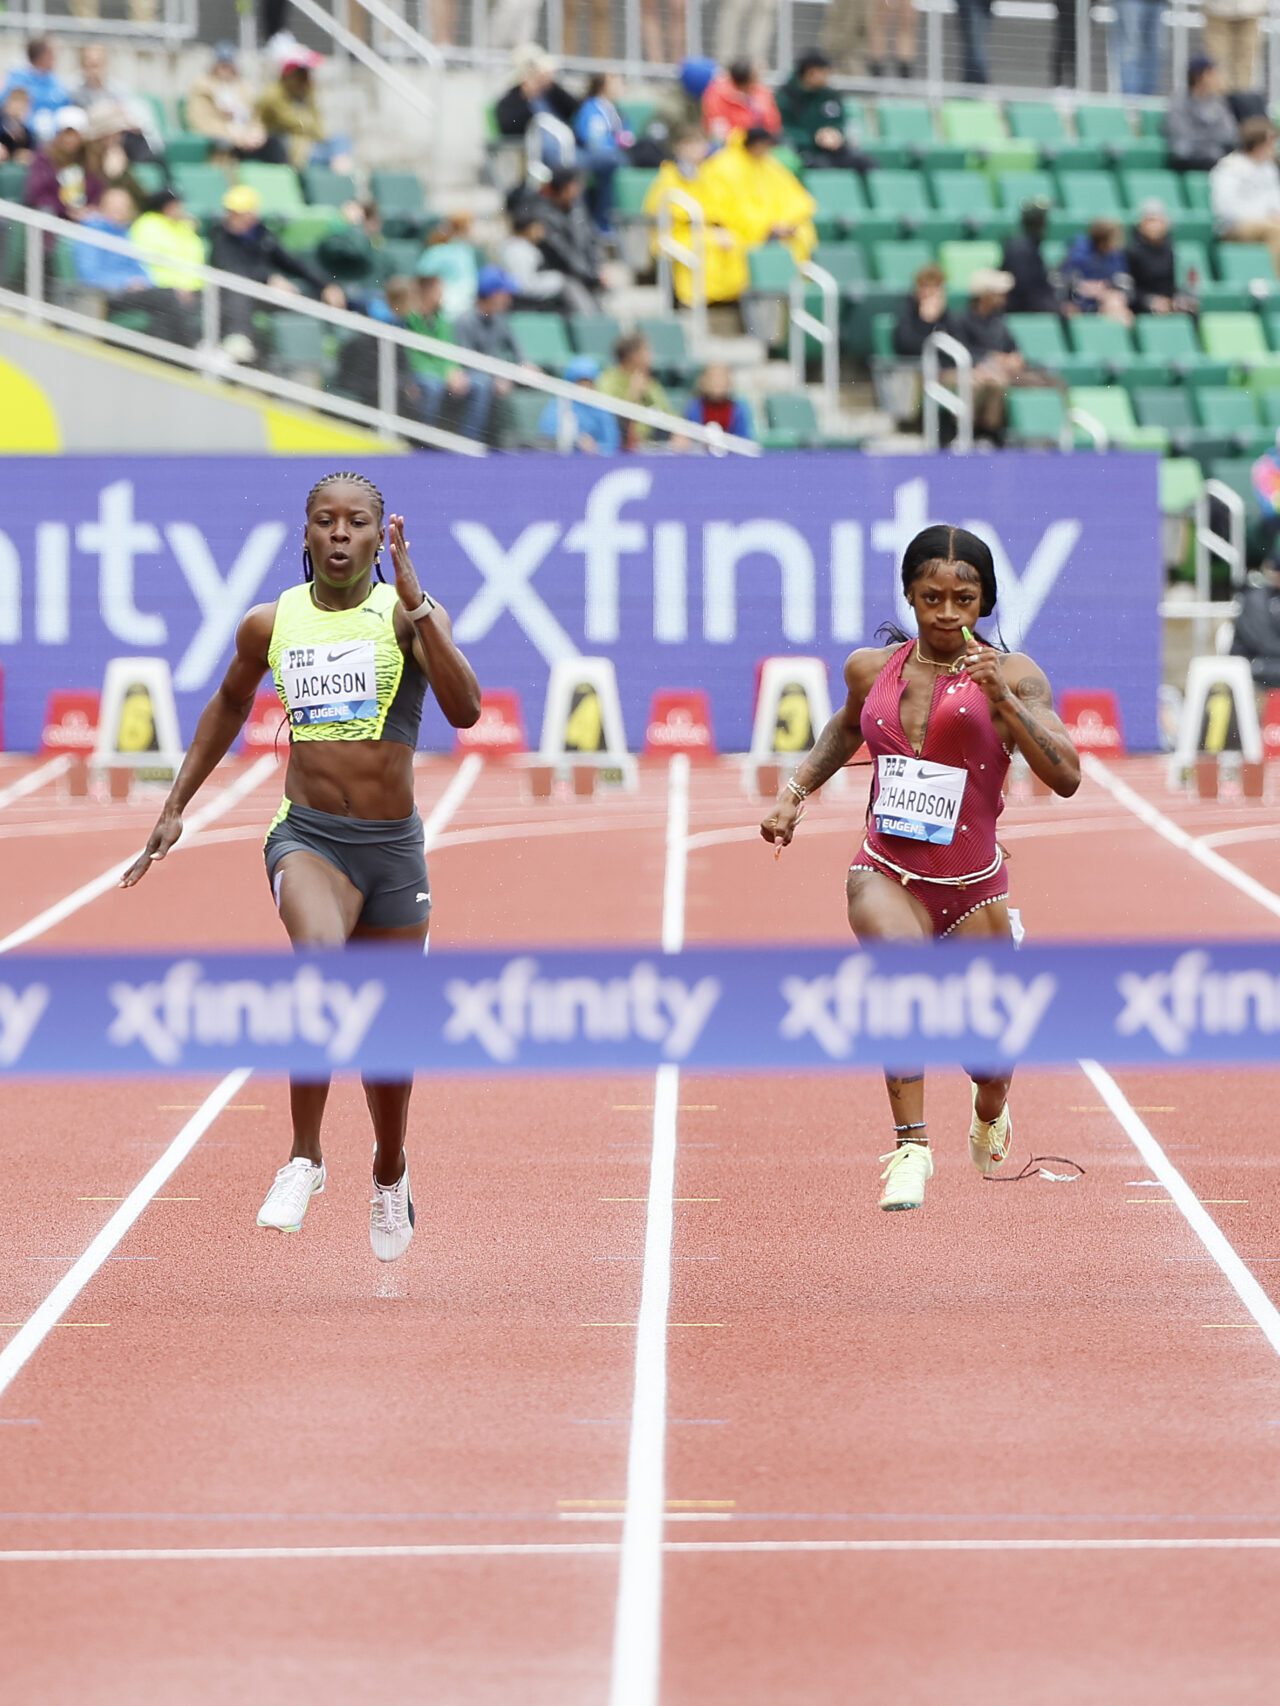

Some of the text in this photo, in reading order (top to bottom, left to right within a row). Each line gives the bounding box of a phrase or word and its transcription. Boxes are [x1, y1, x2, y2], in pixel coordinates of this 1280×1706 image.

[289, 648, 315, 669] PRE
[294, 671, 366, 699] JACKSON
[309, 705, 350, 719] EUGENE
[881, 817, 926, 835] EUGENE
[106, 958, 386, 1066] xfinity
[443, 956, 722, 1064] xfinity
[778, 952, 1058, 1060] xfinity
